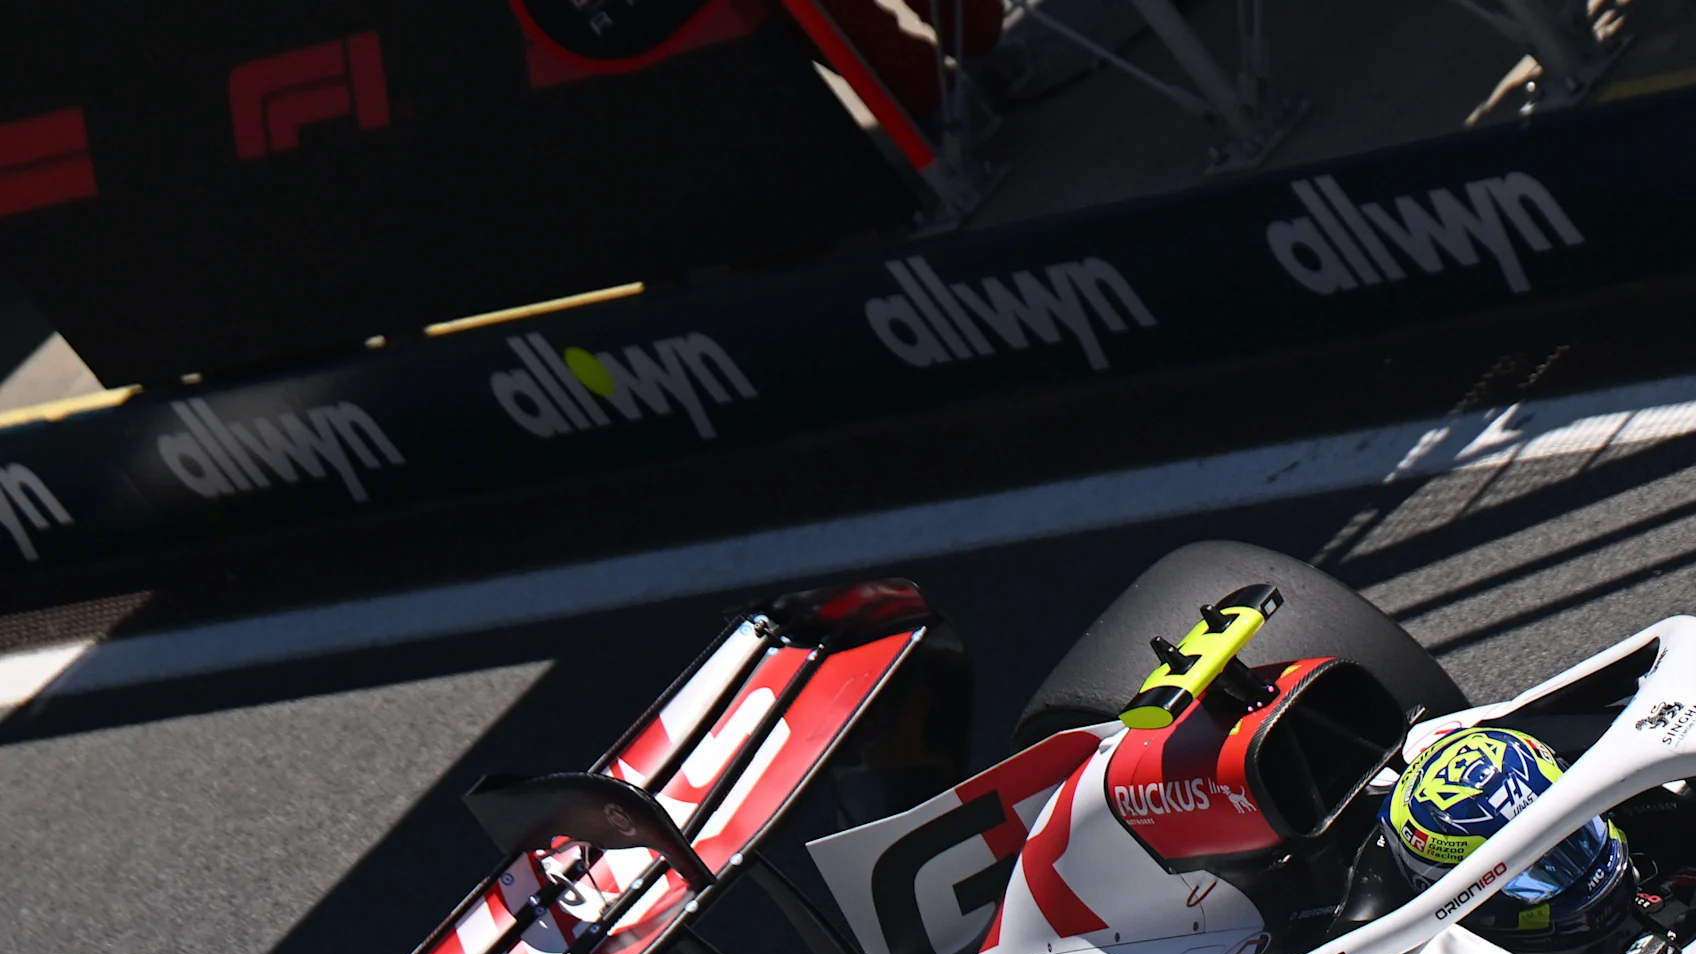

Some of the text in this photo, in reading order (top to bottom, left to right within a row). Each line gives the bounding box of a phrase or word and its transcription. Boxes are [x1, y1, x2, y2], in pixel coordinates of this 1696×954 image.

[1266, 175, 1583, 294] allwyn
[865, 256, 1158, 370] allwyn
[490, 332, 758, 440] allwyn
[157, 398, 406, 501] allwyn
[1113, 776, 1211, 818] RUCKUS
[1401, 825, 1429, 853] GR
[1426, 849, 1465, 862] Racing
[1428, 843, 1466, 854] GAZOO
[1430, 837, 1469, 847] TOYOTA
[1434, 861, 1509, 921] ORION180
